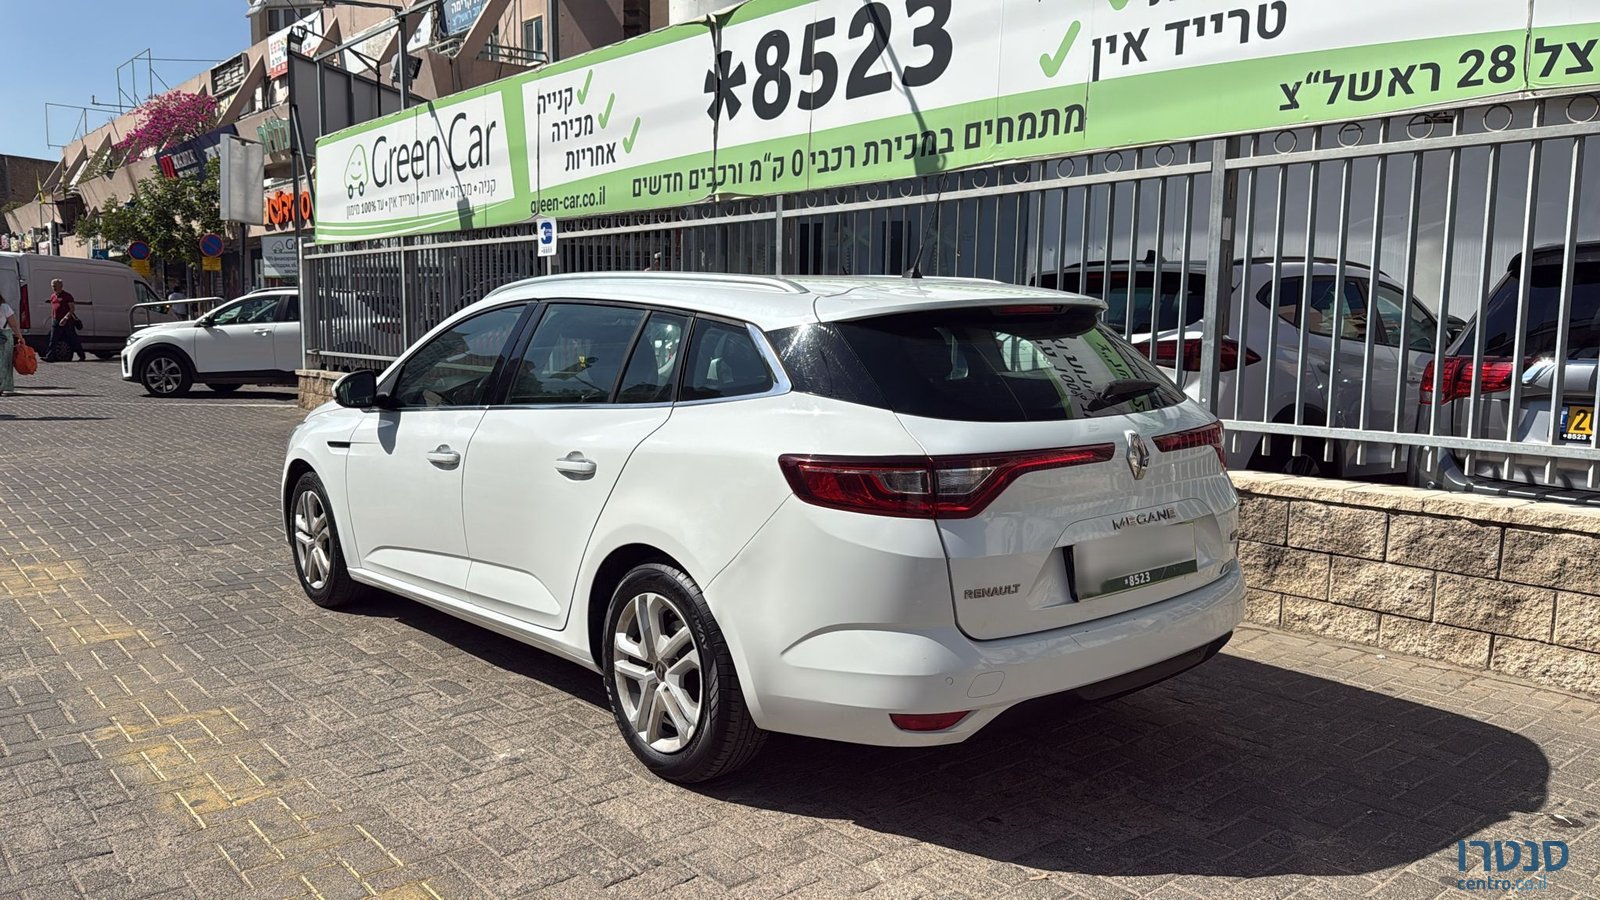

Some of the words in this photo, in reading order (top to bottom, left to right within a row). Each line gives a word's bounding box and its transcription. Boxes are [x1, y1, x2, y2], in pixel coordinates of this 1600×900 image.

[1165, 0, 1287, 56] טרייד
[1092, 27, 1150, 82] אין
[1457, 45, 1517, 88] 28
[537, 87, 573, 115] קנייה
[551, 114, 594, 142] מכירה
[963, 103, 1085, 150] מתמחים
[372, 135, 441, 188] Green
[448, 112, 497, 172] Car
[565, 142, 616, 171] אחריות
[810, 145, 856, 174] רכבי
[862, 127, 954, 167] במכירת
[689, 162, 743, 190] ורכבים
[791, 148, 804, 177] 0
[632, 172, 683, 197] חדשים
[1112, 508, 1176, 530] MEGANE
[964, 583, 1021, 600] RENAULT
